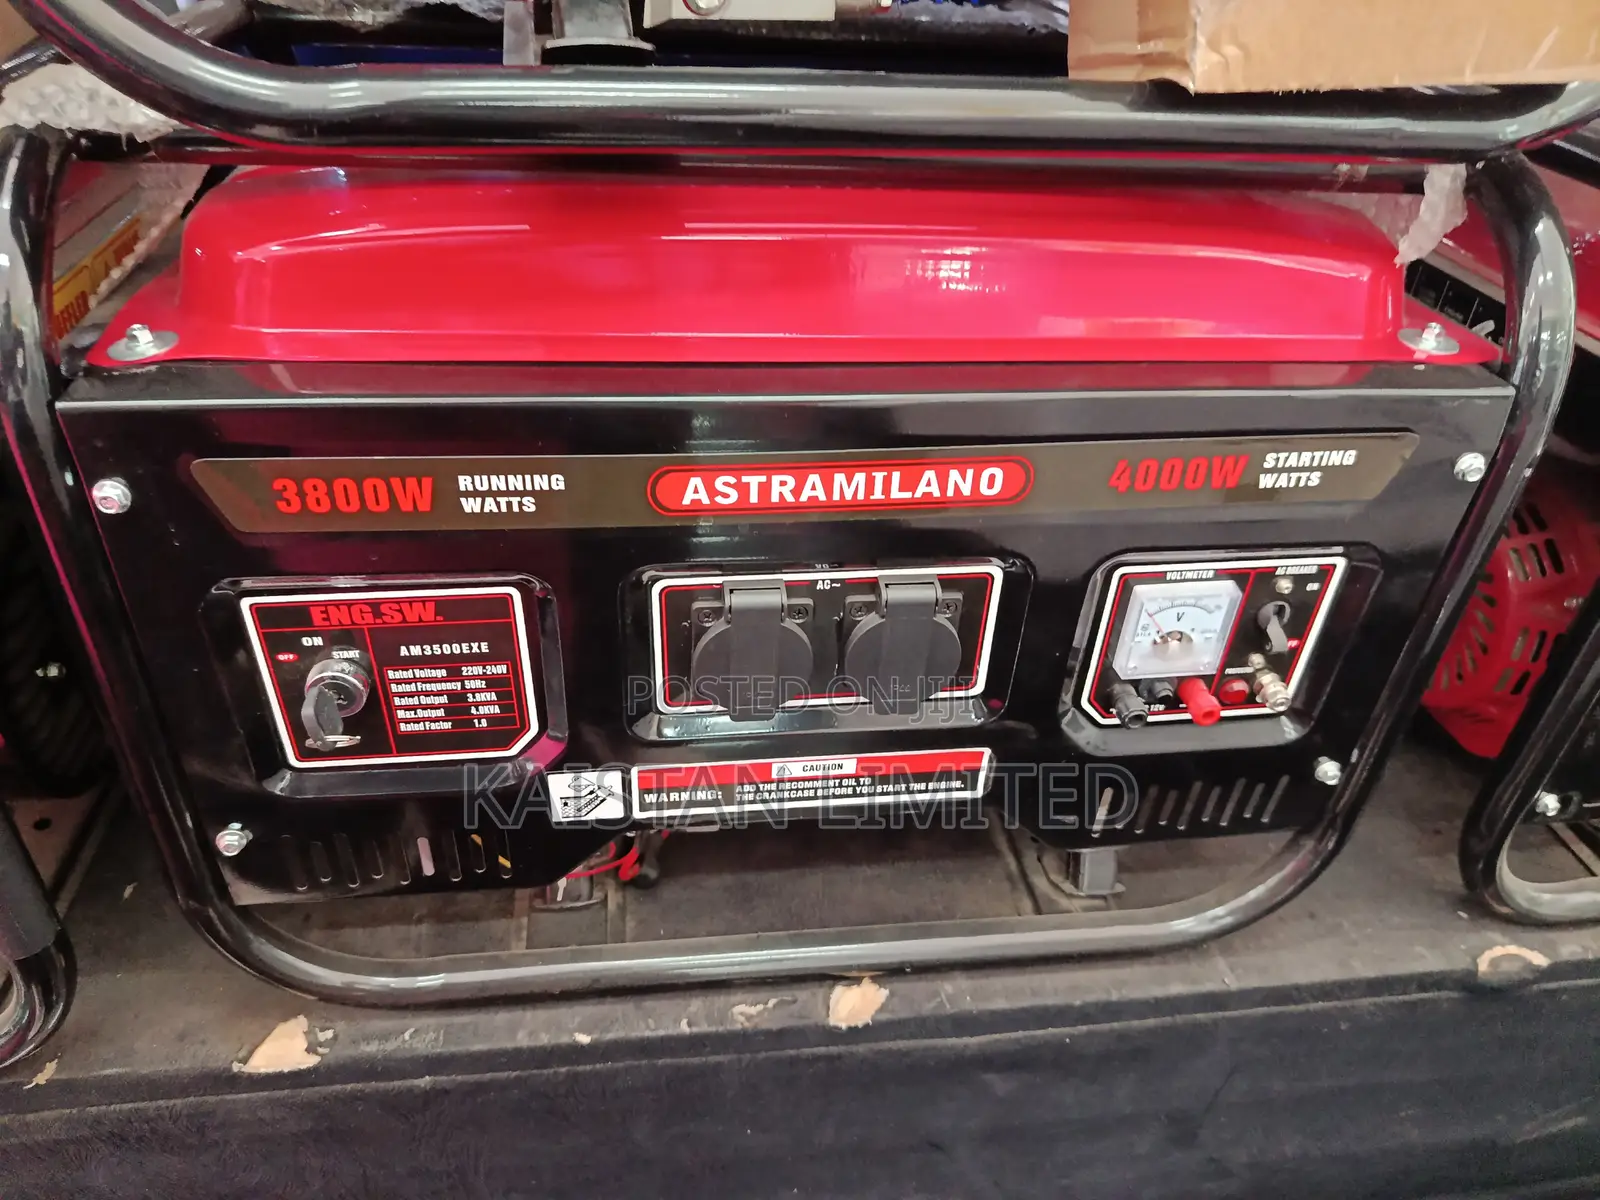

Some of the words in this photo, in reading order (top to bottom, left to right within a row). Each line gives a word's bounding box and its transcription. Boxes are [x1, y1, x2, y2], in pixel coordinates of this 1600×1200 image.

[1263, 450, 1358, 468] STARTING
[1108, 455, 1250, 493] 4000W
[1258, 471, 1322, 489] WATTS
[457, 474, 565, 491] RUNNING
[682, 467, 1004, 505] ASTRAMILANO
[272, 477, 433, 514] 3800W
[460, 496, 536, 513] WATTS
[1166, 570, 1215, 580] VOLTMETER
[309, 601, 444, 626] ENG.SW.
[1176, 612, 1185, 622] V
[301, 636, 324, 646] ON
[331, 650, 360, 659] START
[400, 642, 490, 656] AM3500EXE
[387, 669, 413, 679] Rated
[413, 668, 447, 679] Voltage
[461, 664, 508, 676] 220V-240V
[390, 683, 416, 692] Rated
[417, 681, 462, 692] Frequency
[464, 680, 487, 689] 50Hz
[393, 696, 419, 706] Rated
[419, 694, 449, 705] Output
[470, 705, 500, 715] 4.0KVA
[400, 722, 425, 732] Rated
[425, 720, 452, 731] Factor
[473, 719, 488, 728] 1.0
[802, 763, 844, 773] CAUTION
[736, 785, 757, 793] ADD
[759, 783, 777, 791] THE
[779, 779, 841, 791] RECOMMENT
[842, 778, 857, 787] OIL
[859, 777, 872, 786] TO
[736, 793, 754, 801] THE
[756, 789, 815, 800] CRANKCASE
[816, 787, 853, 797] BEFORE
[855, 786, 874, 795] YOU
[876, 784, 907, 793] START
[909, 782, 926, 791] THE
[643, 791, 723, 804] WARNING:
